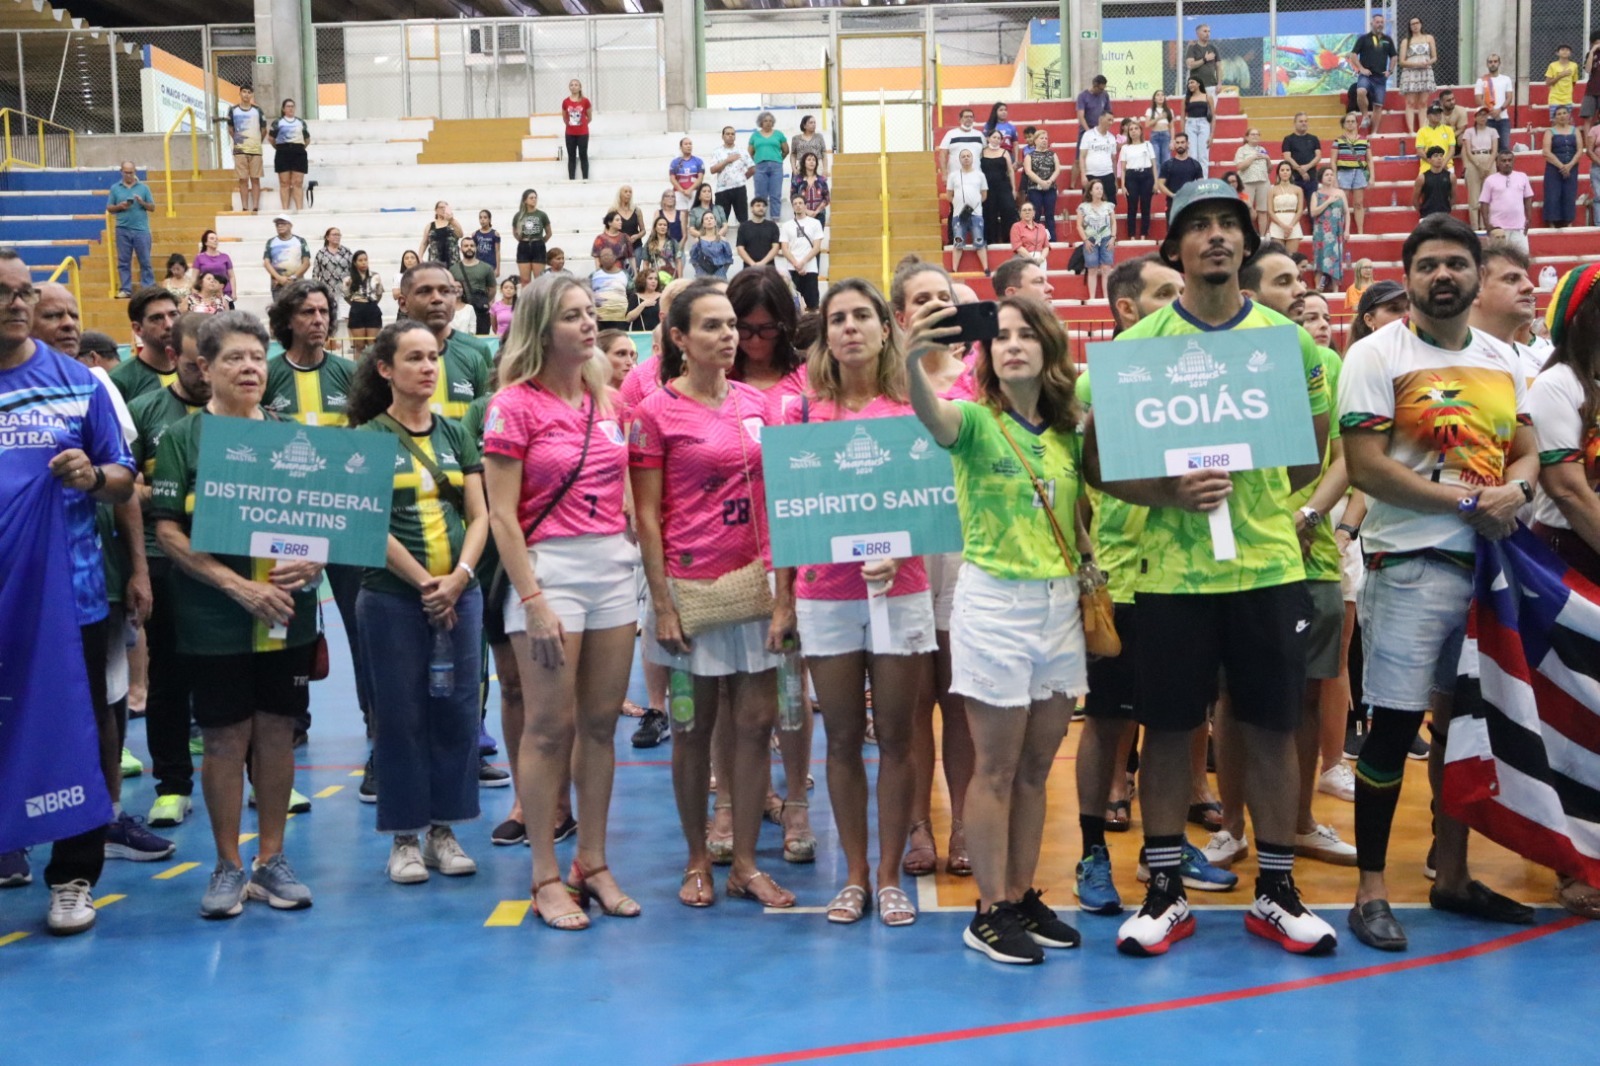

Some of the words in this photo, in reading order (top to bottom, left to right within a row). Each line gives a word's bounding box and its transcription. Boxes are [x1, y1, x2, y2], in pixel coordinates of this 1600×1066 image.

[1101, 49, 1133, 60] ulturA
[1118, 373, 1152, 384] ANASTRA
[1135, 384, 1269, 429] GOIÁS
[0, 431, 54, 446] UTRA
[790, 459, 822, 469] ANASTRA
[1203, 454, 1230, 467] BRB
[204, 481, 292, 504] DISTRITO
[297, 490, 383, 512] FEDERAL
[584, 494, 598, 518] 7
[775, 492, 877, 518] ESPÍRITO
[882, 486, 957, 510] SANTO
[239, 506, 347, 530] TOCANTINS
[723, 498, 750, 525] 28
[283, 543, 309, 556] BRB
[866, 541, 891, 555] BRB
[45, 785, 85, 813] BRB
